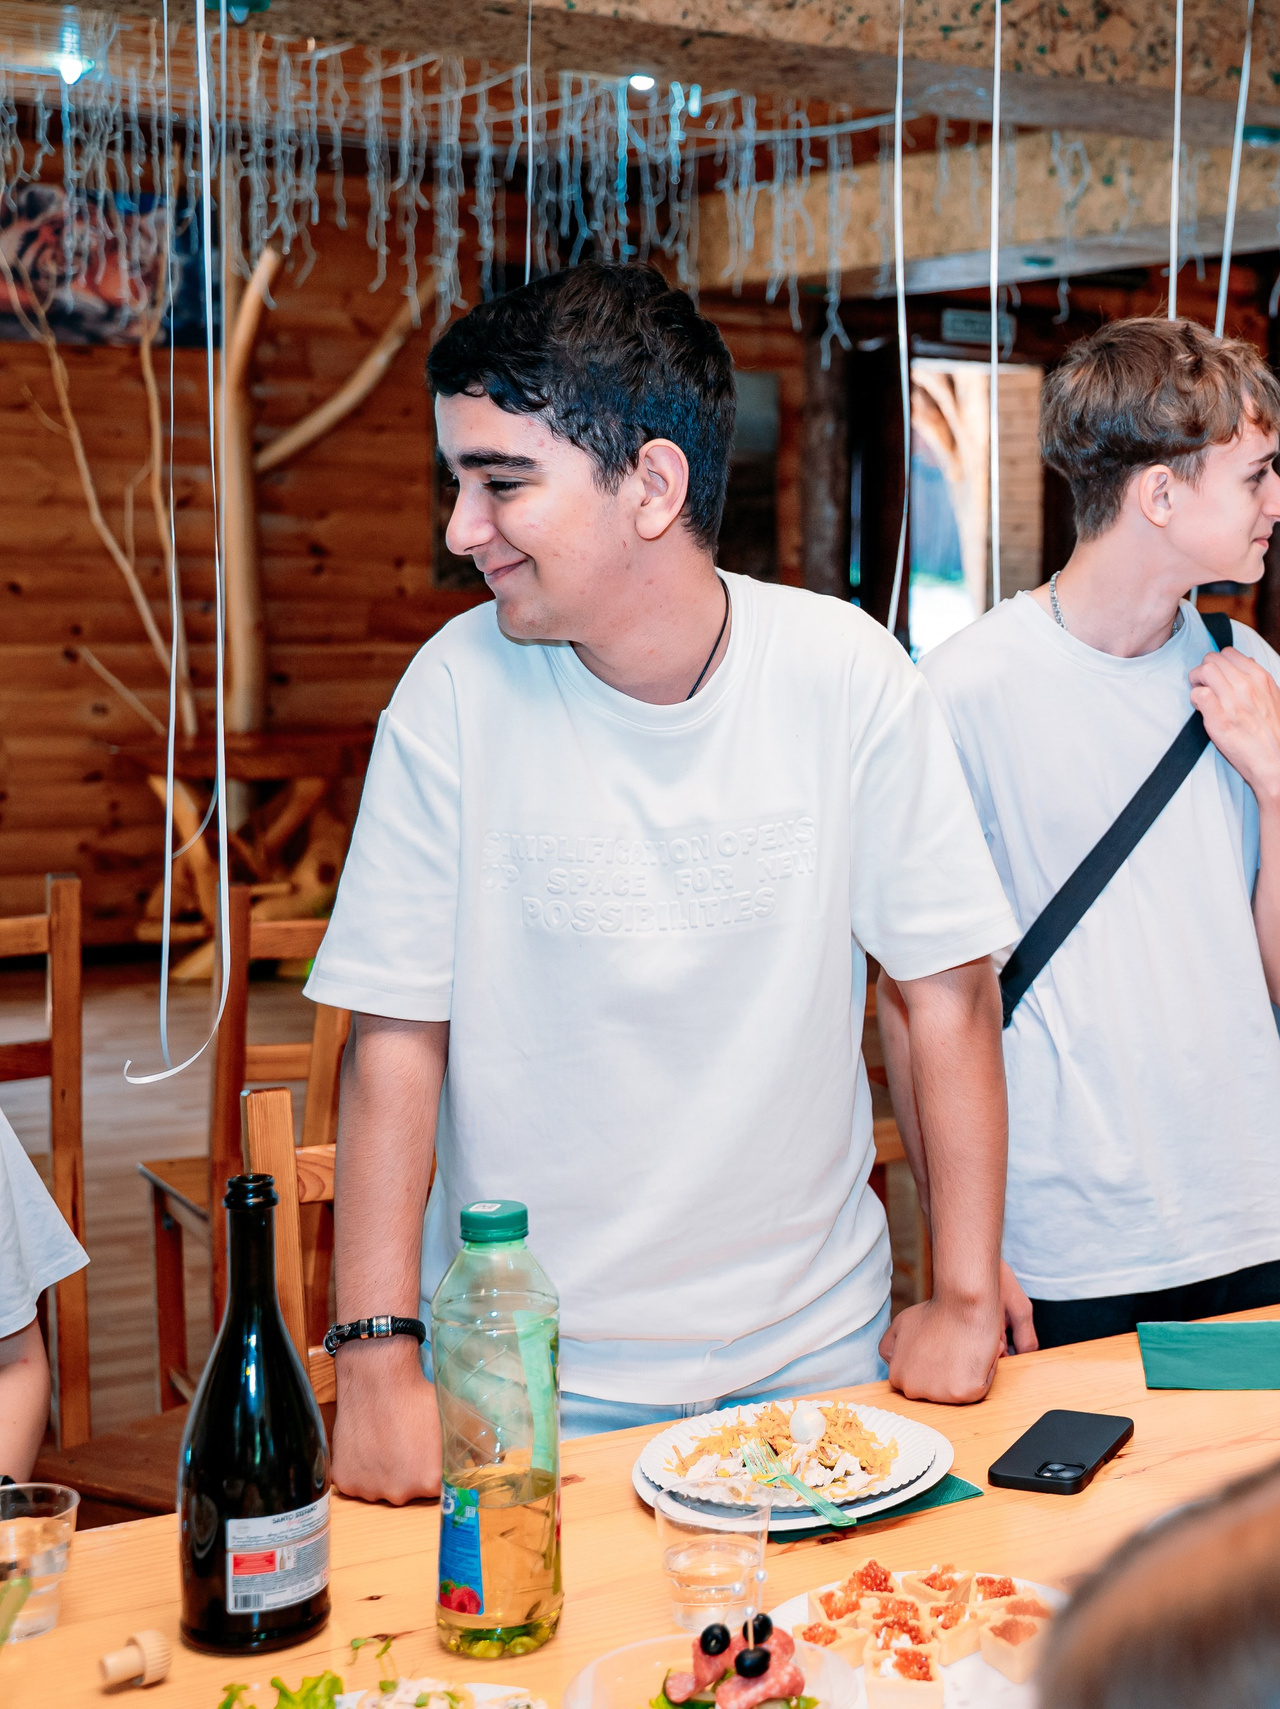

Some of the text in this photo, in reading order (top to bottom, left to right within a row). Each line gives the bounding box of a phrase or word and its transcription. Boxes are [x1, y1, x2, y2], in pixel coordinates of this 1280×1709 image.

[483, 816, 816, 866] SIMPLIFICATION OPENS
[480, 848, 817, 897] UP SPACE FOR NEW
[522, 887, 777, 933] POSSIBILITIES
[272, 1514, 294, 1524] SANTO
